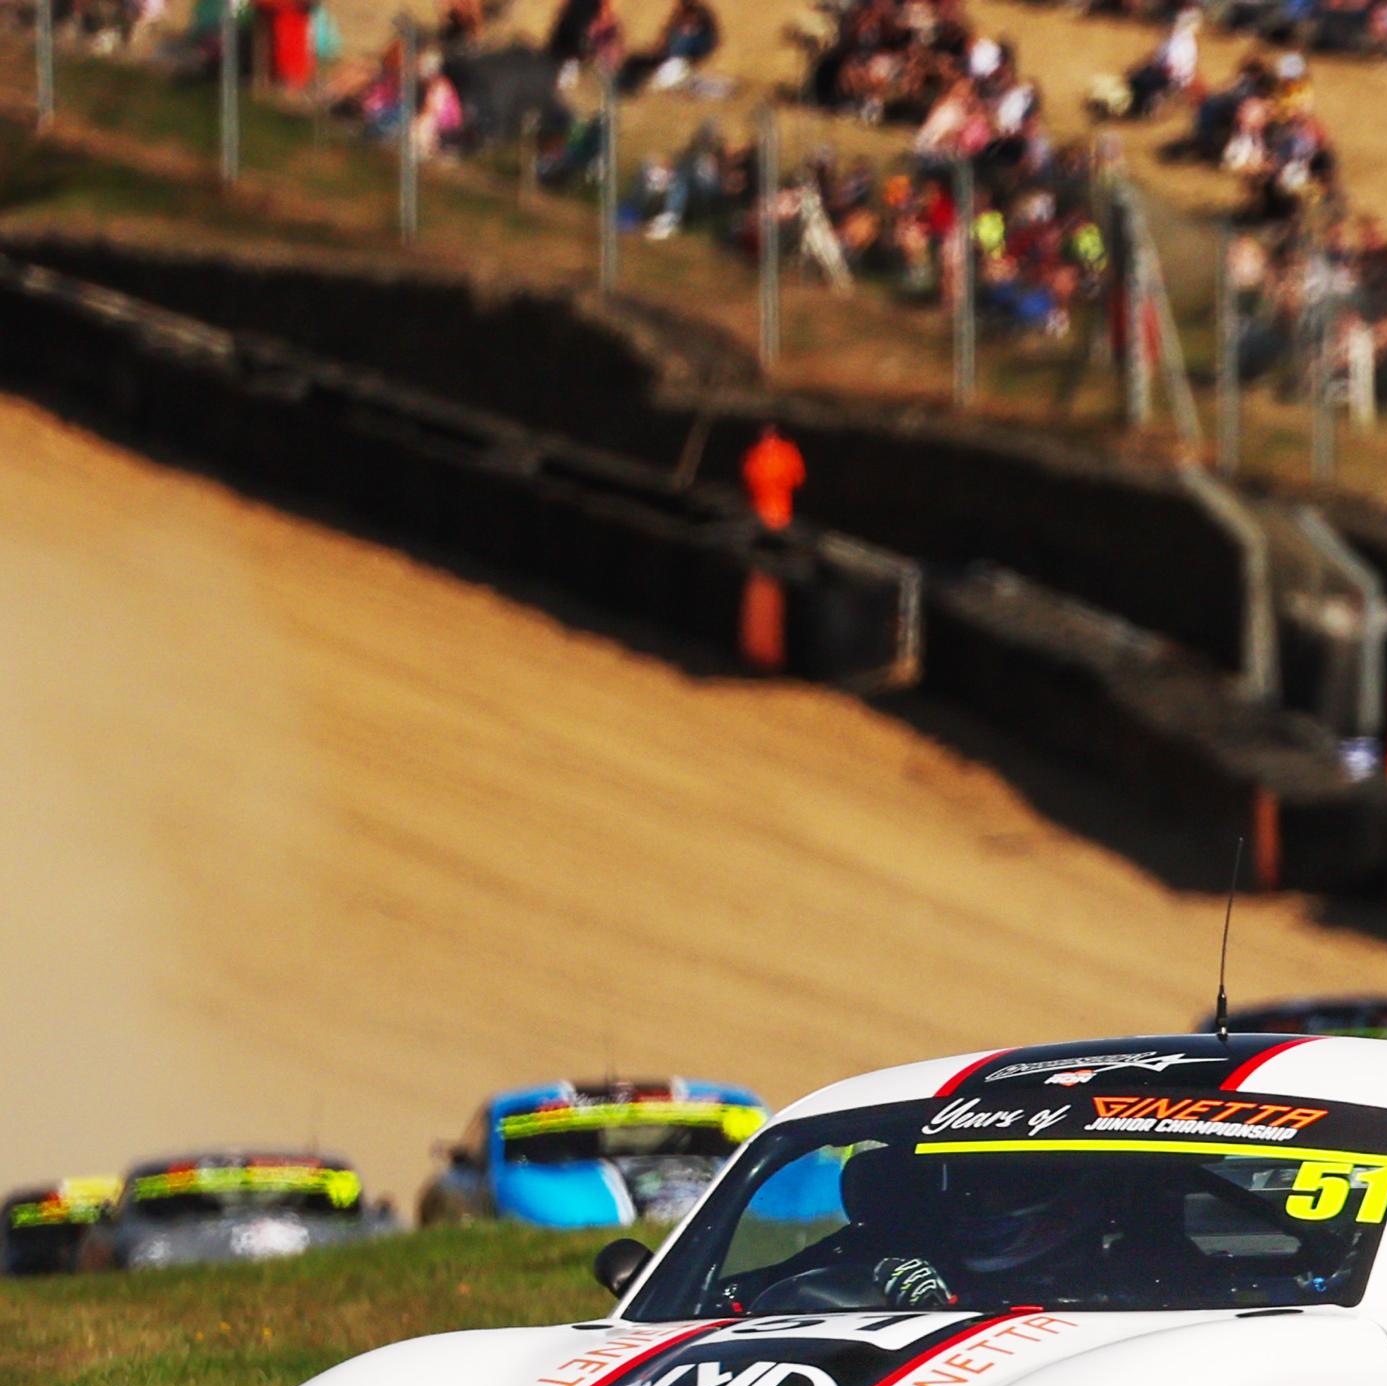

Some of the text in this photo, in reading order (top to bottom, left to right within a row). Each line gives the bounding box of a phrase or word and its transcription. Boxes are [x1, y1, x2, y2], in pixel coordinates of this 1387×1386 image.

[922, 1098, 1072, 1136] Years of
[1092, 1096, 1328, 1129] GINETTA
[1084, 1117, 1299, 1142] JUNIOR CHAMPIONSHIP
